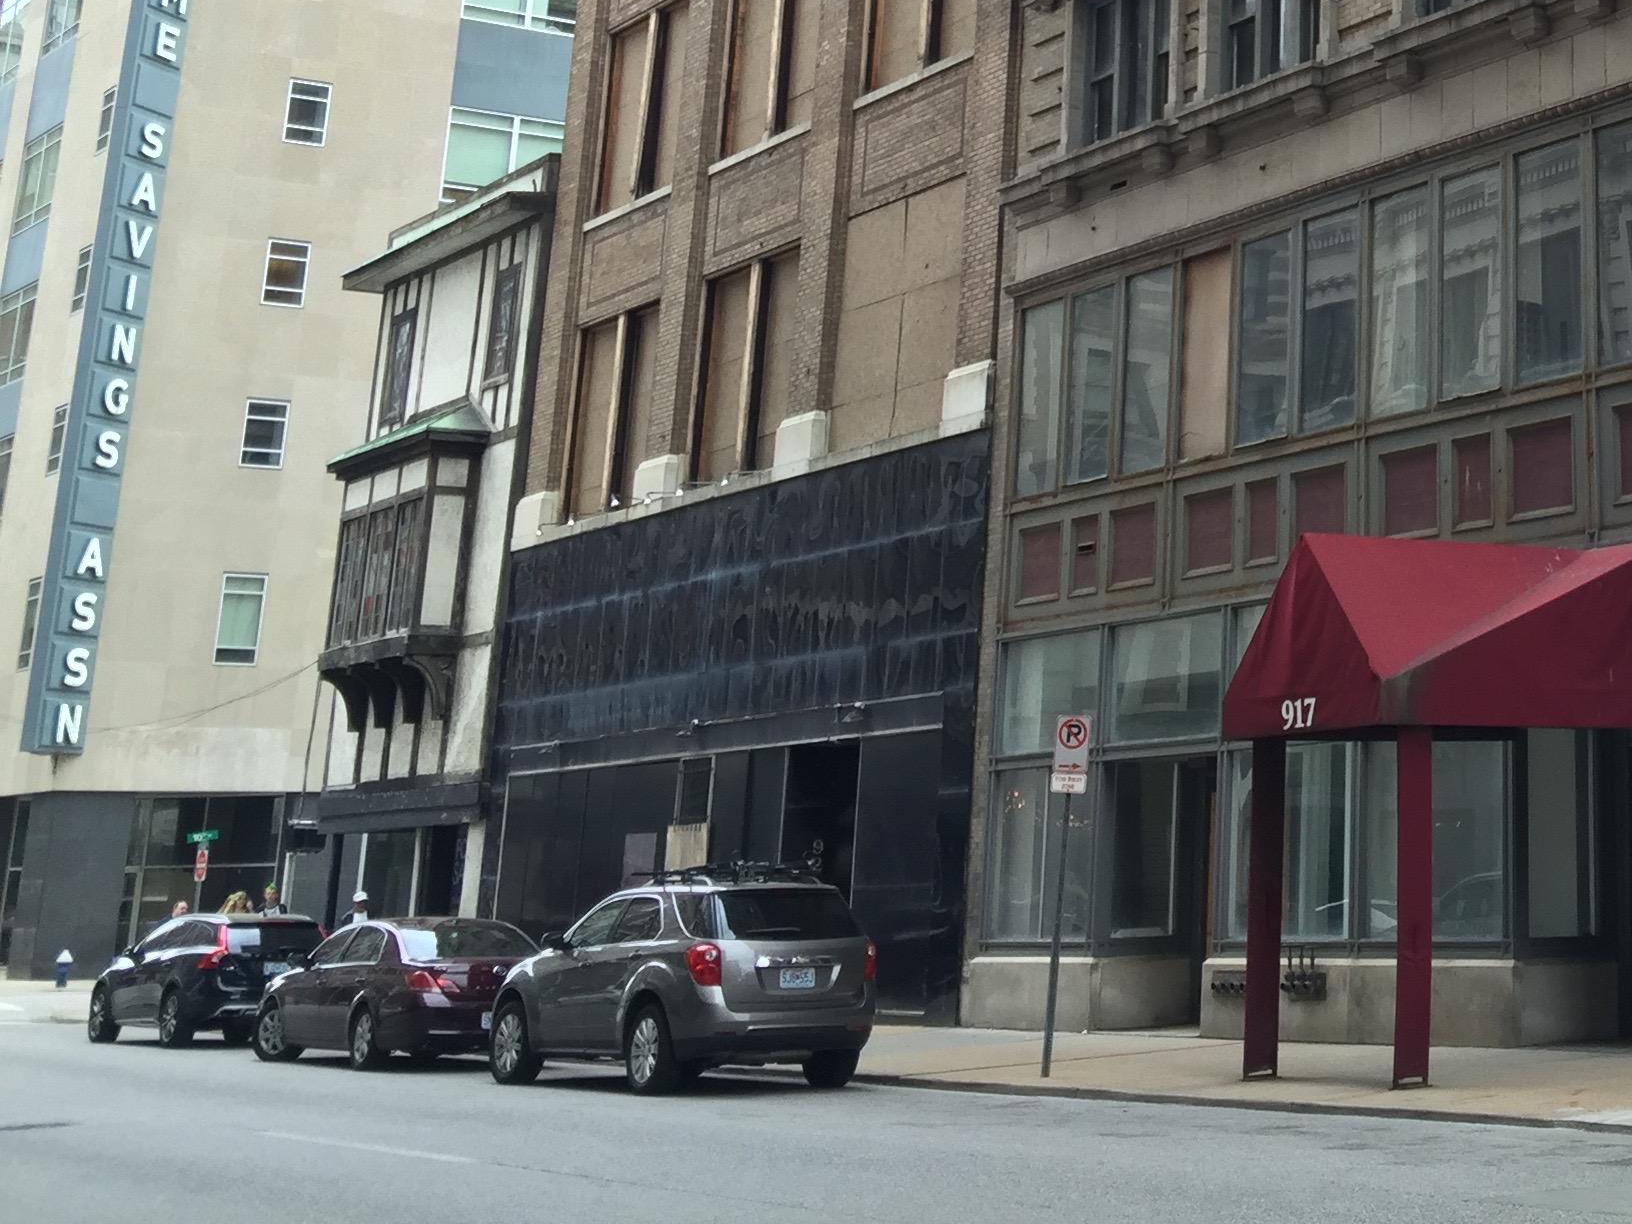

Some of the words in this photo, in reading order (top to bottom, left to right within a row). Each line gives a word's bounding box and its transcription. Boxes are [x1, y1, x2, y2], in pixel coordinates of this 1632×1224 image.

[95, 120, 165, 469] SAVINGS
[56, 535, 103, 745] ASSN
[1281, 697, 1317, 731] 917
